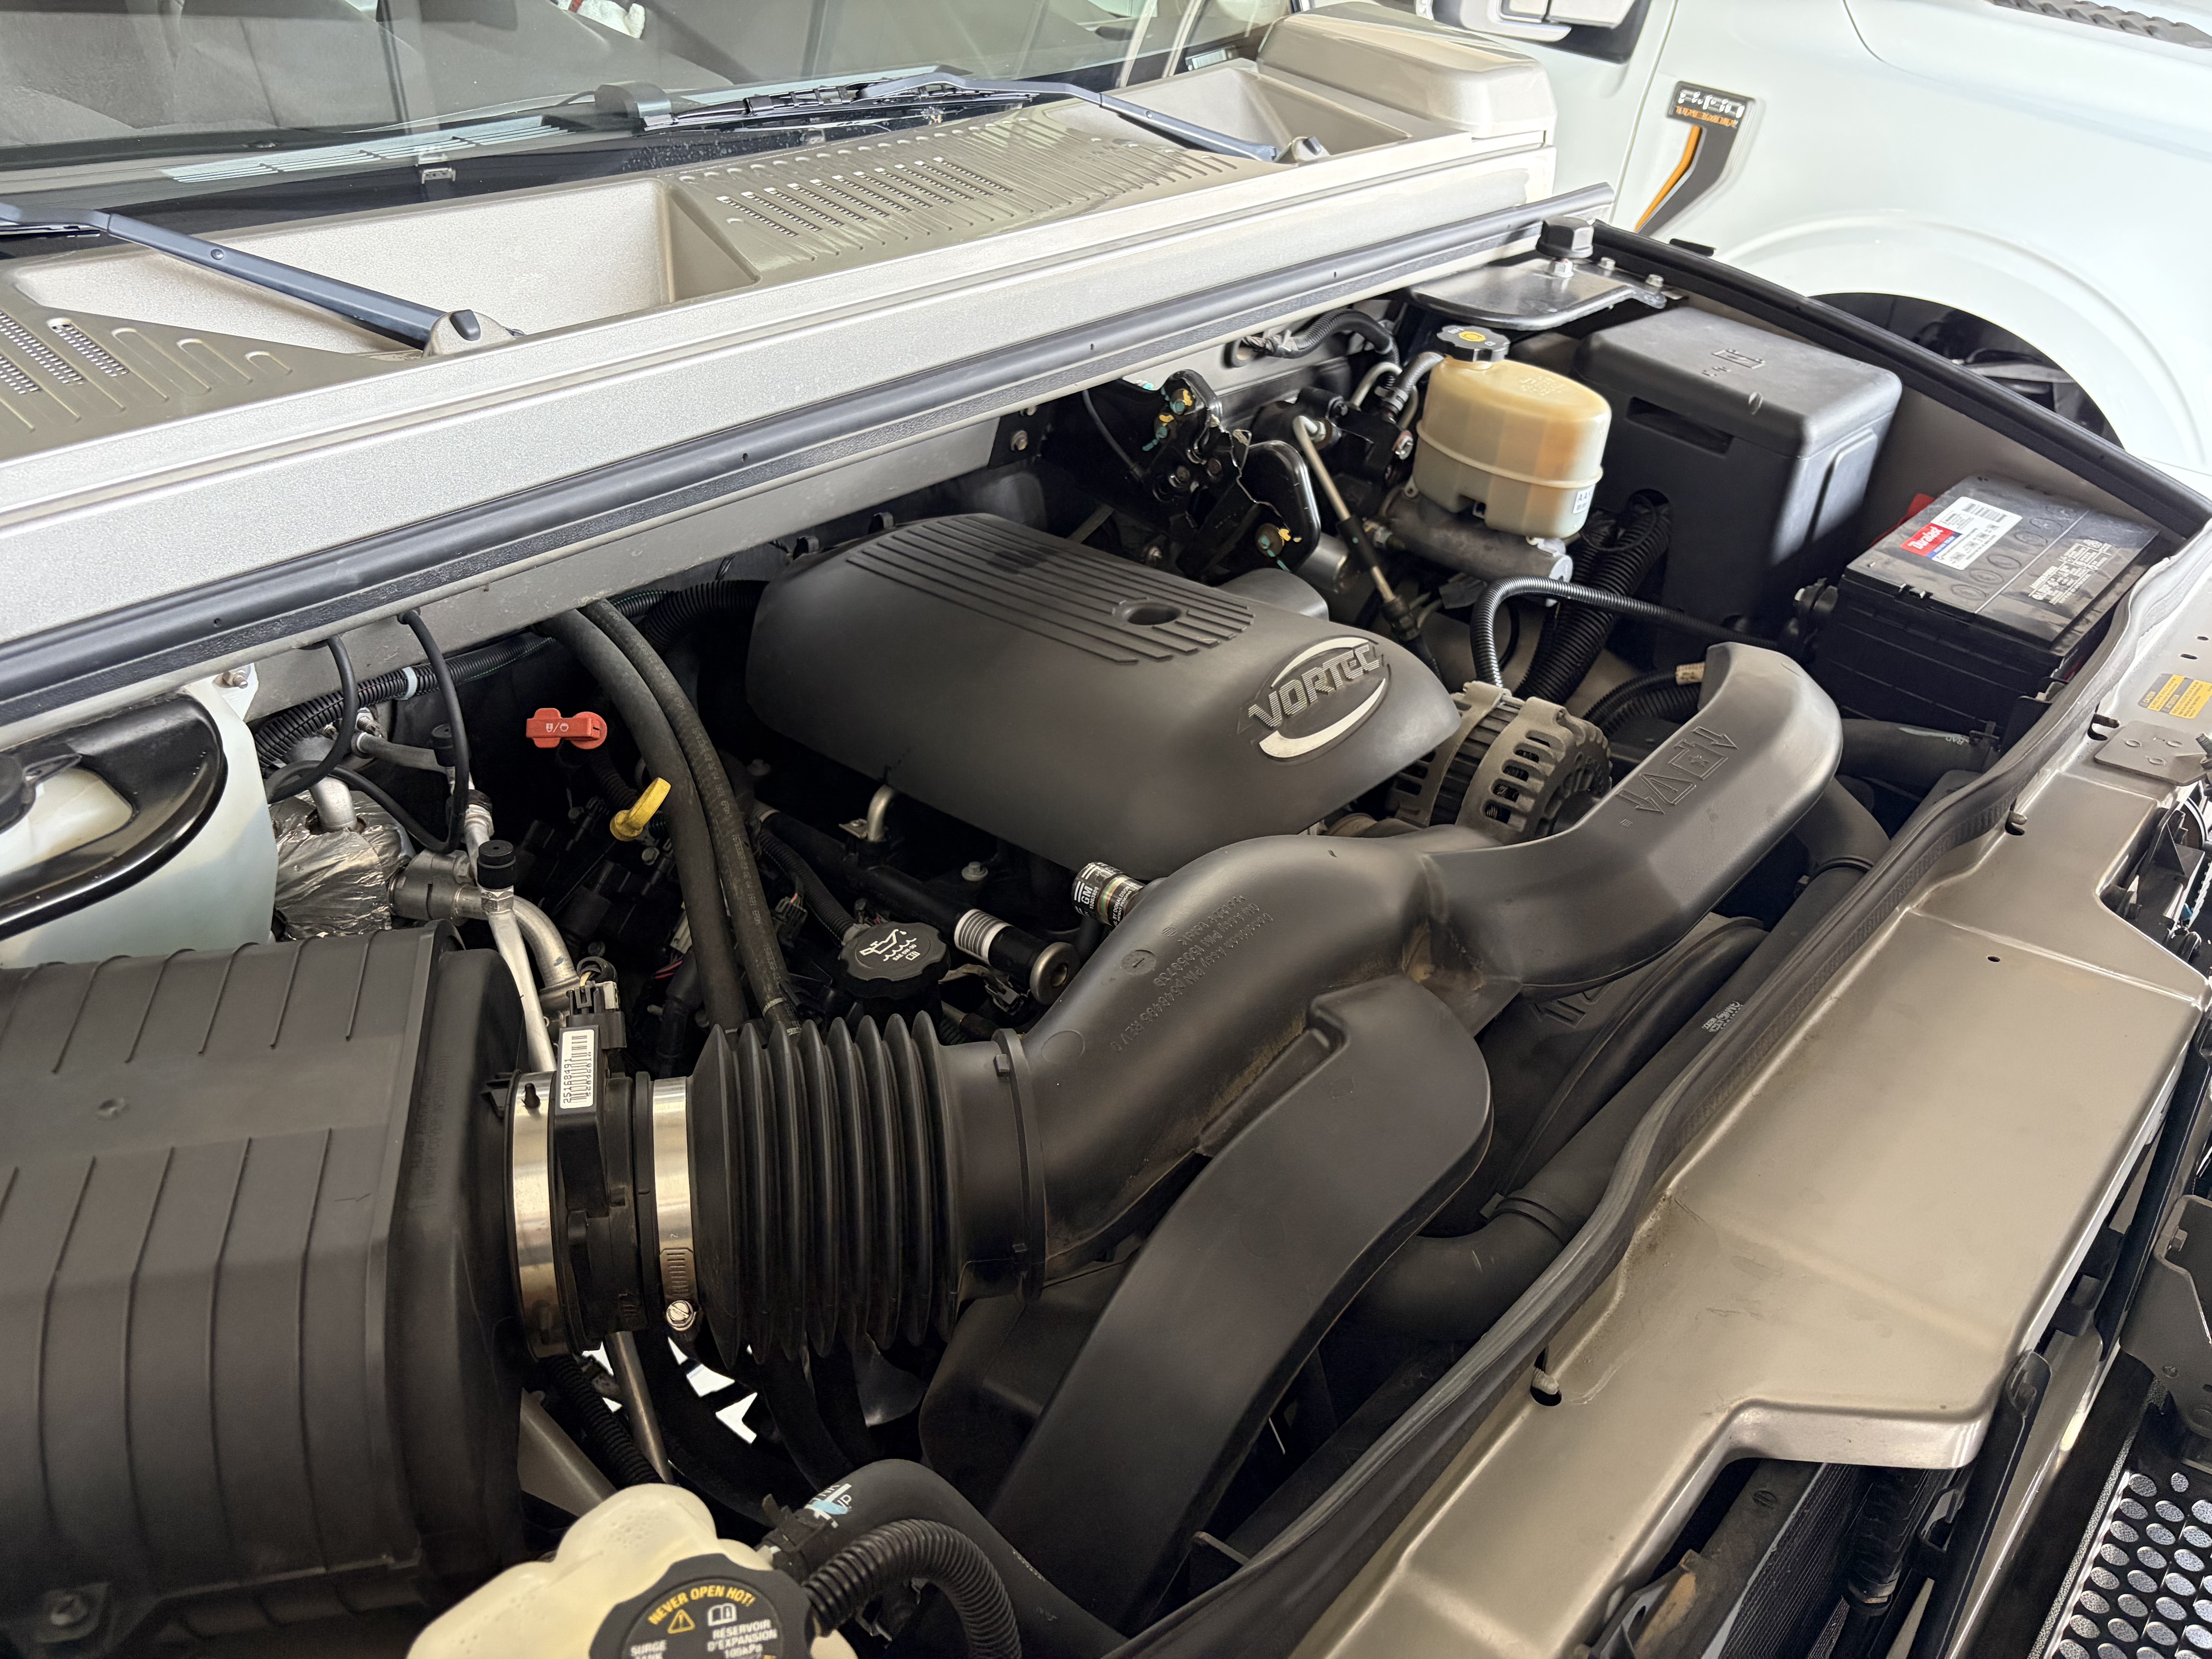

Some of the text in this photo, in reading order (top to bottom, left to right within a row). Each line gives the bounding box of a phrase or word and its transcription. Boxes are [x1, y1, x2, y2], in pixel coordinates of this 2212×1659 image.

[1907, 526, 1944, 550] Duralast
[1248, 644, 1380, 727] VORTEC
[1081, 885, 1093, 905] GM
[1113, 885, 1130, 913] DONALDSON
[563, 1058, 572, 1103] 25168491
[648, 1585, 756, 1625] NEVER OPEN HOT!
